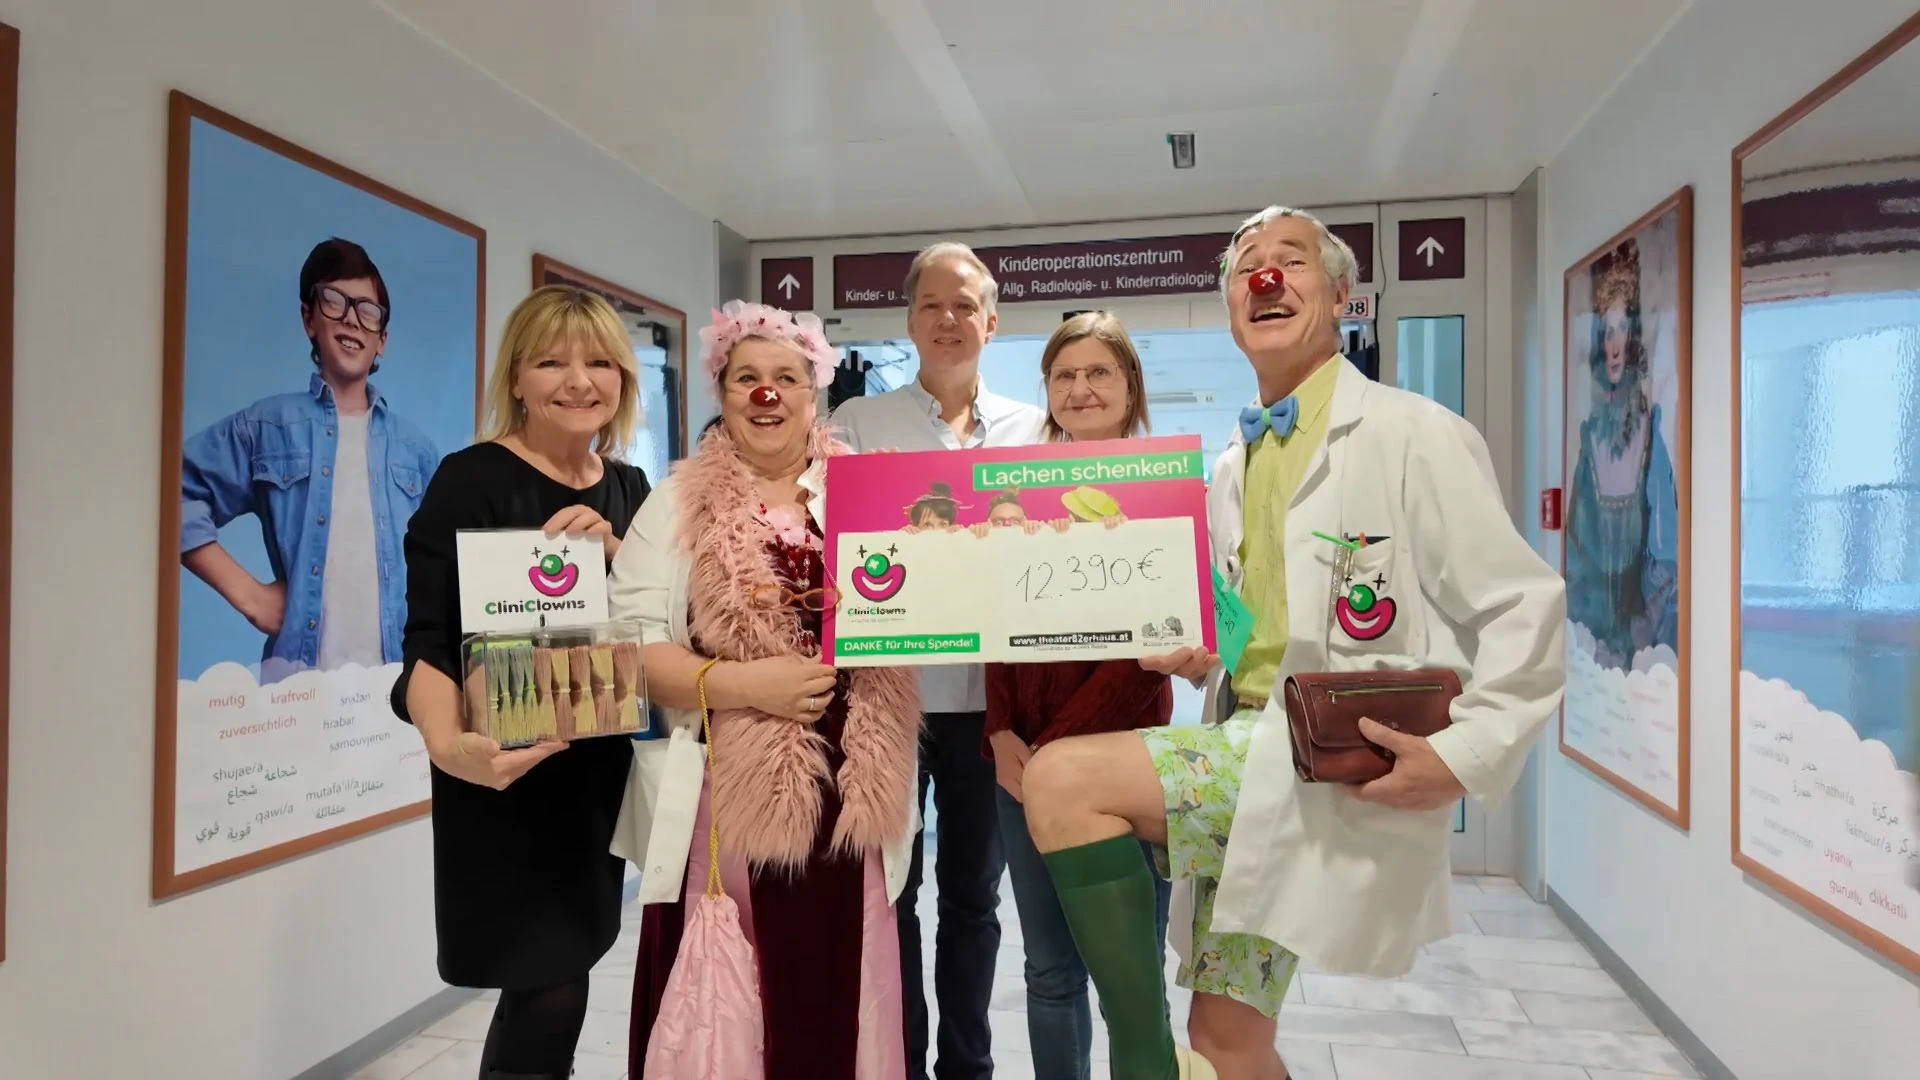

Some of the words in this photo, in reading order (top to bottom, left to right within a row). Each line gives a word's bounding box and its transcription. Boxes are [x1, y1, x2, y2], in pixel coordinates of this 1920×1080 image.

[999, 249, 1184, 272] Kinderoperationszentrum
[845, 289, 885, 302] Kinder-
[887, 290, 898, 301] u.
[1002, 282, 1027, 298] Allg.
[1031, 278, 1097, 295] Radiologie-
[1101, 280, 1112, 290] u.
[1116, 271, 1216, 288] Kinderradiologie
[981, 465, 1065, 486] Lachen
[1071, 456, 1189, 481] schenken!
[485, 598, 586, 615] CliniClowns
[847, 606, 907, 616] CliniClowns
[844, 640, 882, 651] DANKE
[885, 638, 900, 649] für
[904, 638, 925, 649] Ihre
[928, 638, 974, 651] Spende!
[208, 694, 246, 709] mutig
[271, 688, 316, 704] kraftvoll
[219, 715, 297, 740] zuversichtlich
